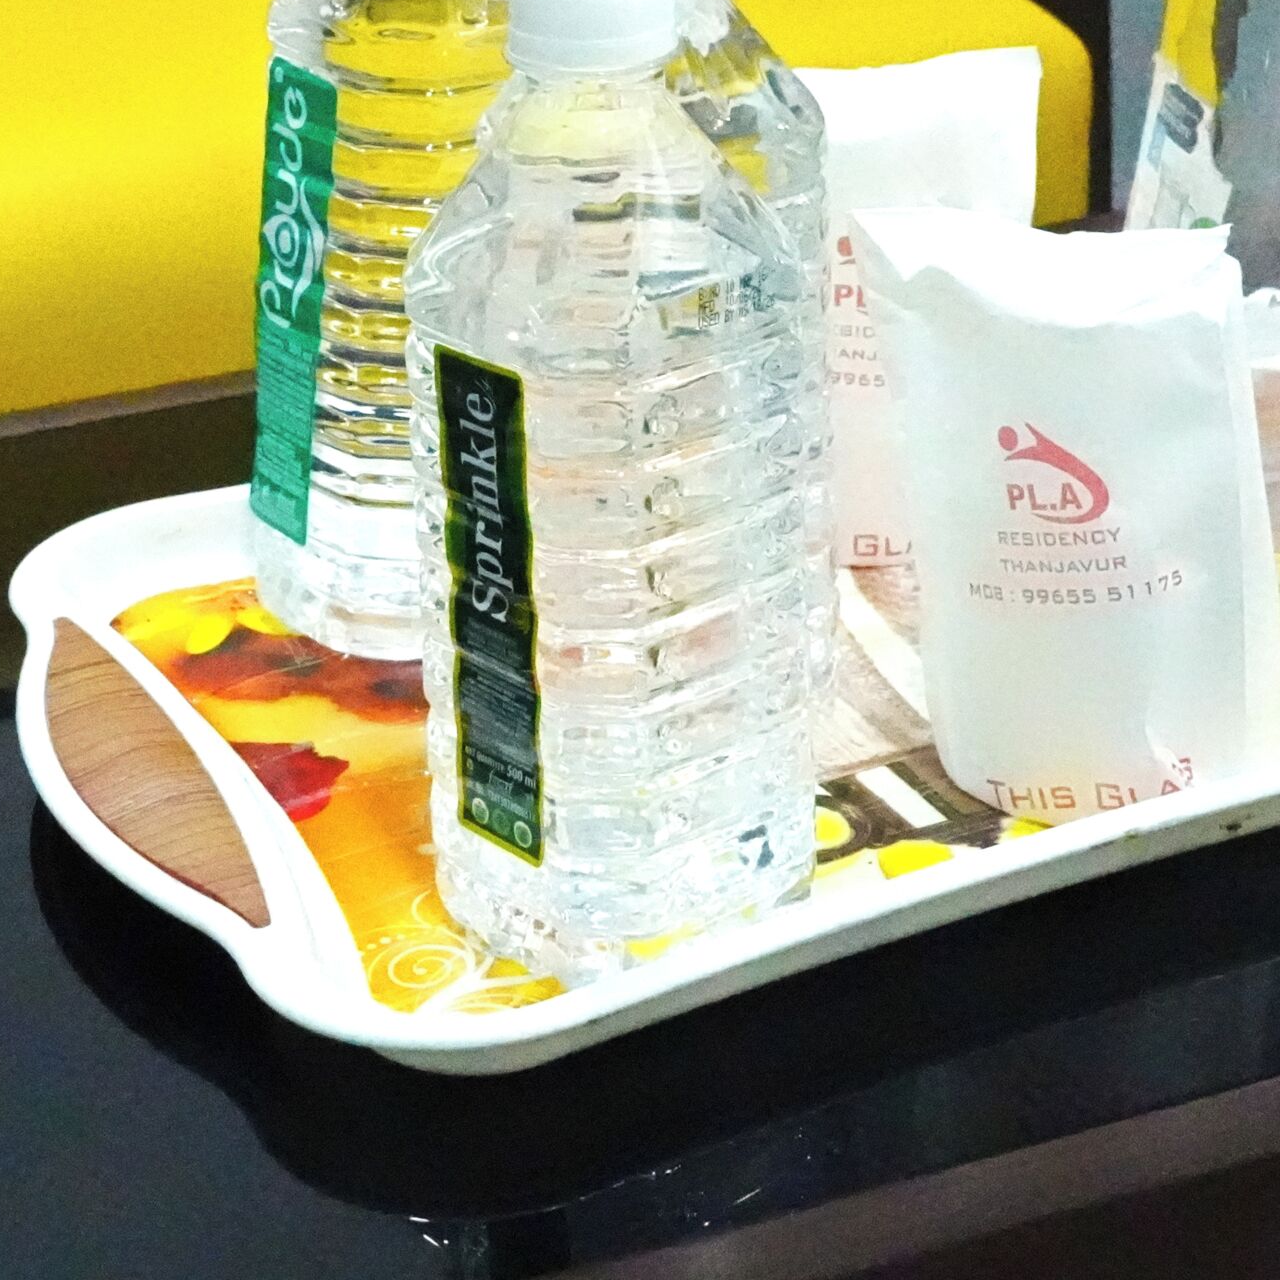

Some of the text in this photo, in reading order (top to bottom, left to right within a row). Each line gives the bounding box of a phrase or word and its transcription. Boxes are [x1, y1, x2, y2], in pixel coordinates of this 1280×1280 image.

[260, 85, 308, 329] Proude
[459, 392, 513, 622] Sprinkle
[853, 534, 912, 557] GL
[997, 526, 1121, 547] RESIDENCY
[999, 555, 1128, 574] THANJAVUR
[1021, 588, 1097, 604] 99655
[1107, 569, 1183, 603] 51175
[986, 779, 1077, 810] THIS
